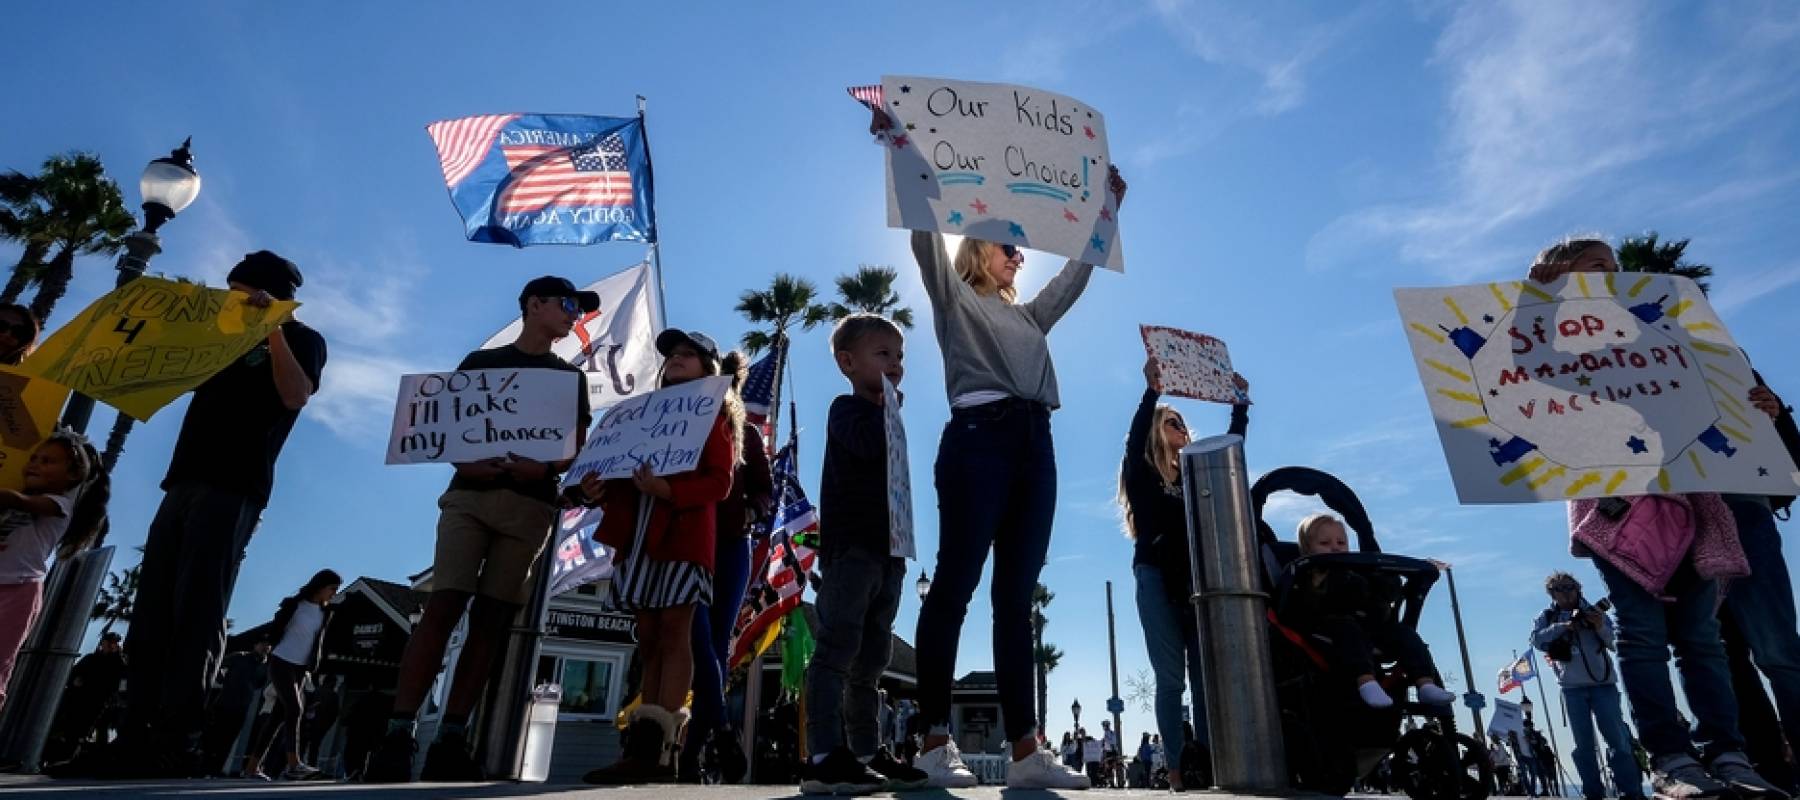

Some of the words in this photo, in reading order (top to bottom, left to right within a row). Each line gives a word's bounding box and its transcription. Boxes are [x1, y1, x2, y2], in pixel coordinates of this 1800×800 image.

[927, 86, 989, 117] Our
[1013, 90, 1074, 136] Kids
[933, 140, 986, 171] Our
[1004, 145, 1091, 198] Choice!
[113, 316, 146, 344] 4
[1499, 344, 1688, 386] MANDATORY
[414, 371, 520, 398] .001%
[599, 393, 652, 430] God
[650, 394, 715, 432] gave
[400, 430, 447, 459] my
[588, 431, 622, 449] me
[650, 419, 689, 439] an
